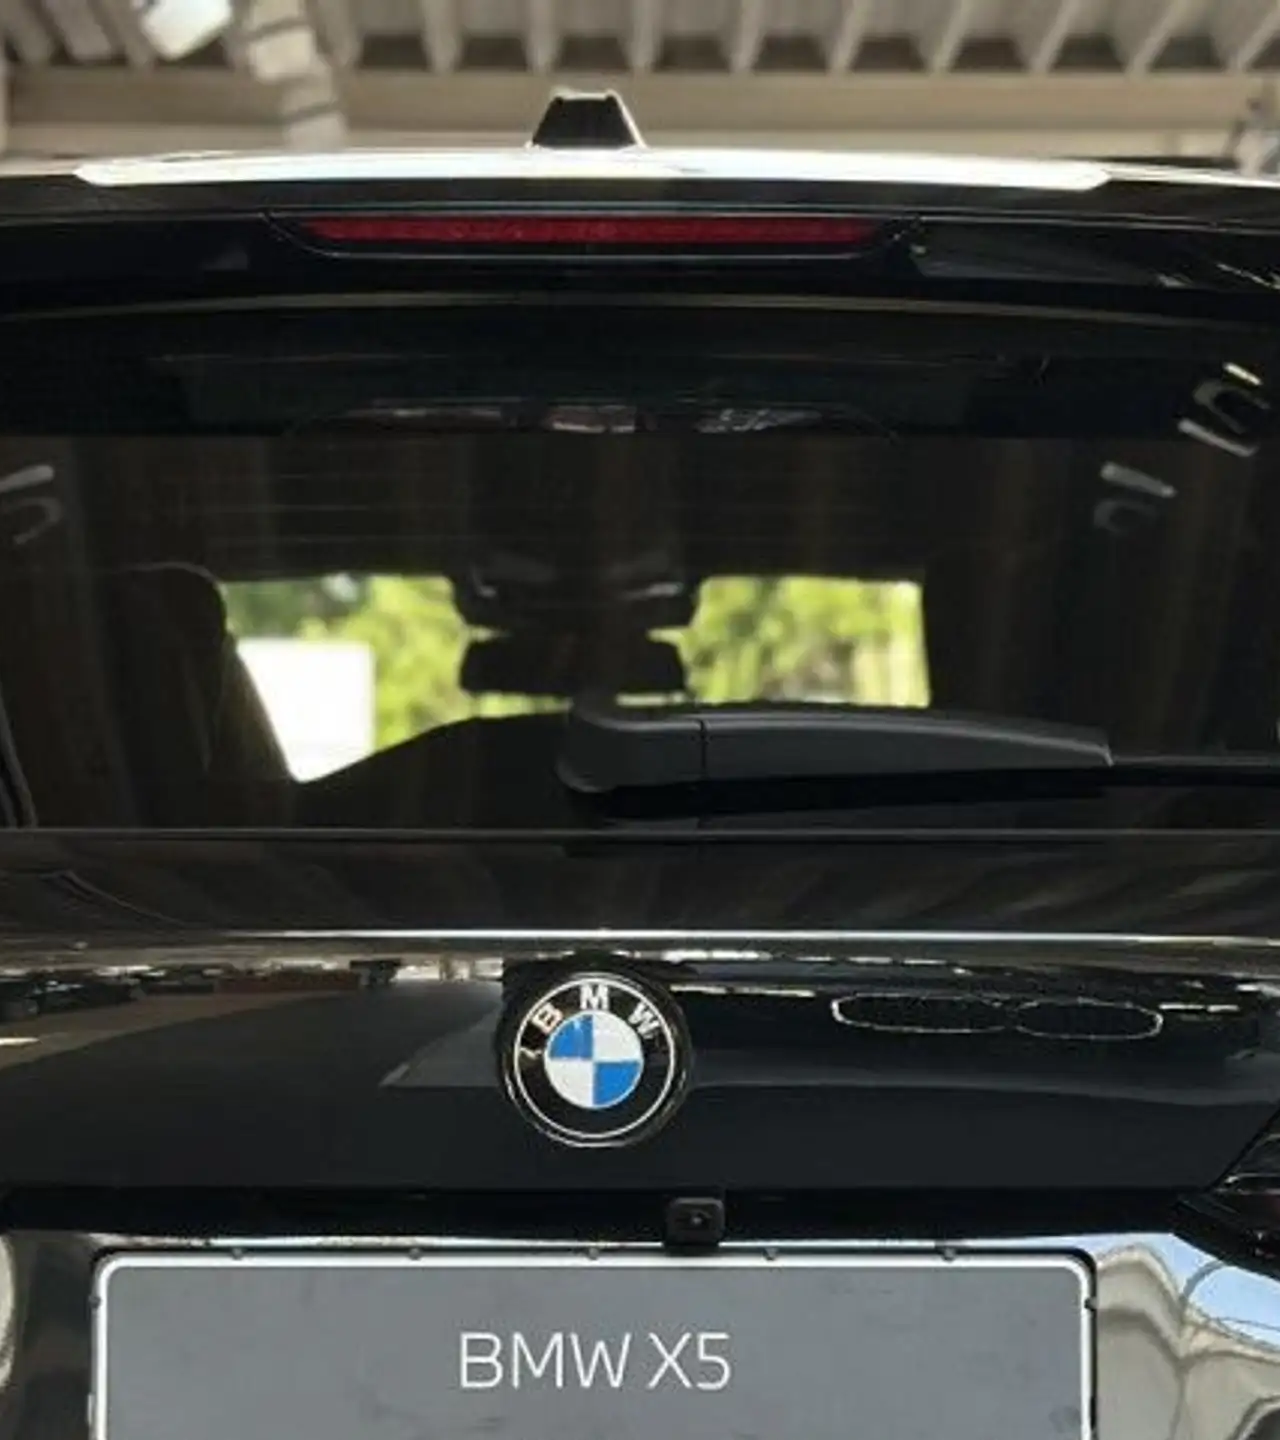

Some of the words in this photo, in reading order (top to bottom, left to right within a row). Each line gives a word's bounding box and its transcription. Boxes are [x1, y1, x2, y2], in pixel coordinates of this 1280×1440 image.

[531, 983, 660, 1040] BMW
[460, 1331, 631, 1389] BMW
[647, 1331, 732, 1391] X5
